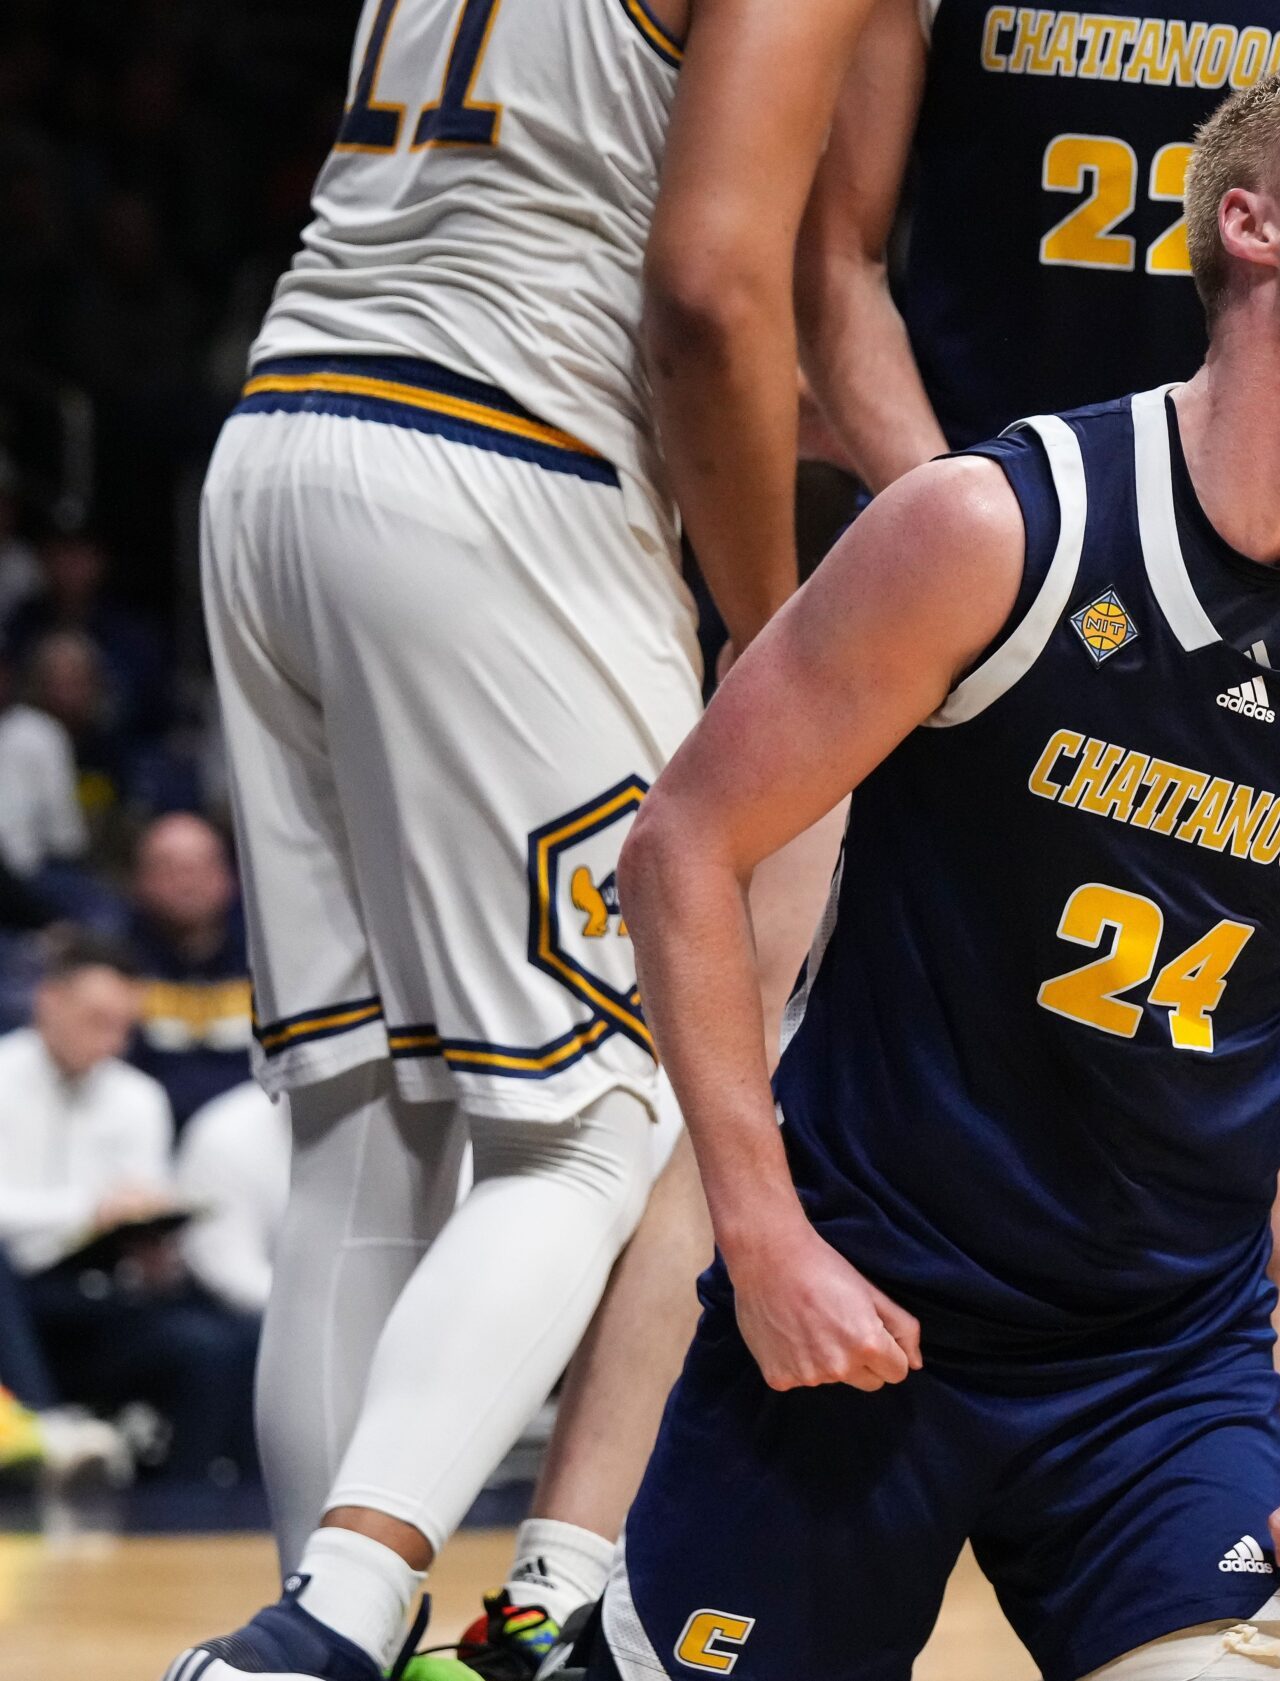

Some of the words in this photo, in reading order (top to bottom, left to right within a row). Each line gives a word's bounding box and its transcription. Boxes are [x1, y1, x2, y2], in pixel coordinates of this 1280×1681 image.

[333, 0, 502, 153] 11
[1086, 616, 1125, 636] NIT
[1216, 693, 1276, 723] adidas
[1036, 882, 1255, 1053] 24
[1218, 1557, 1273, 1574] adidas
[673, 1608, 756, 1675] C
